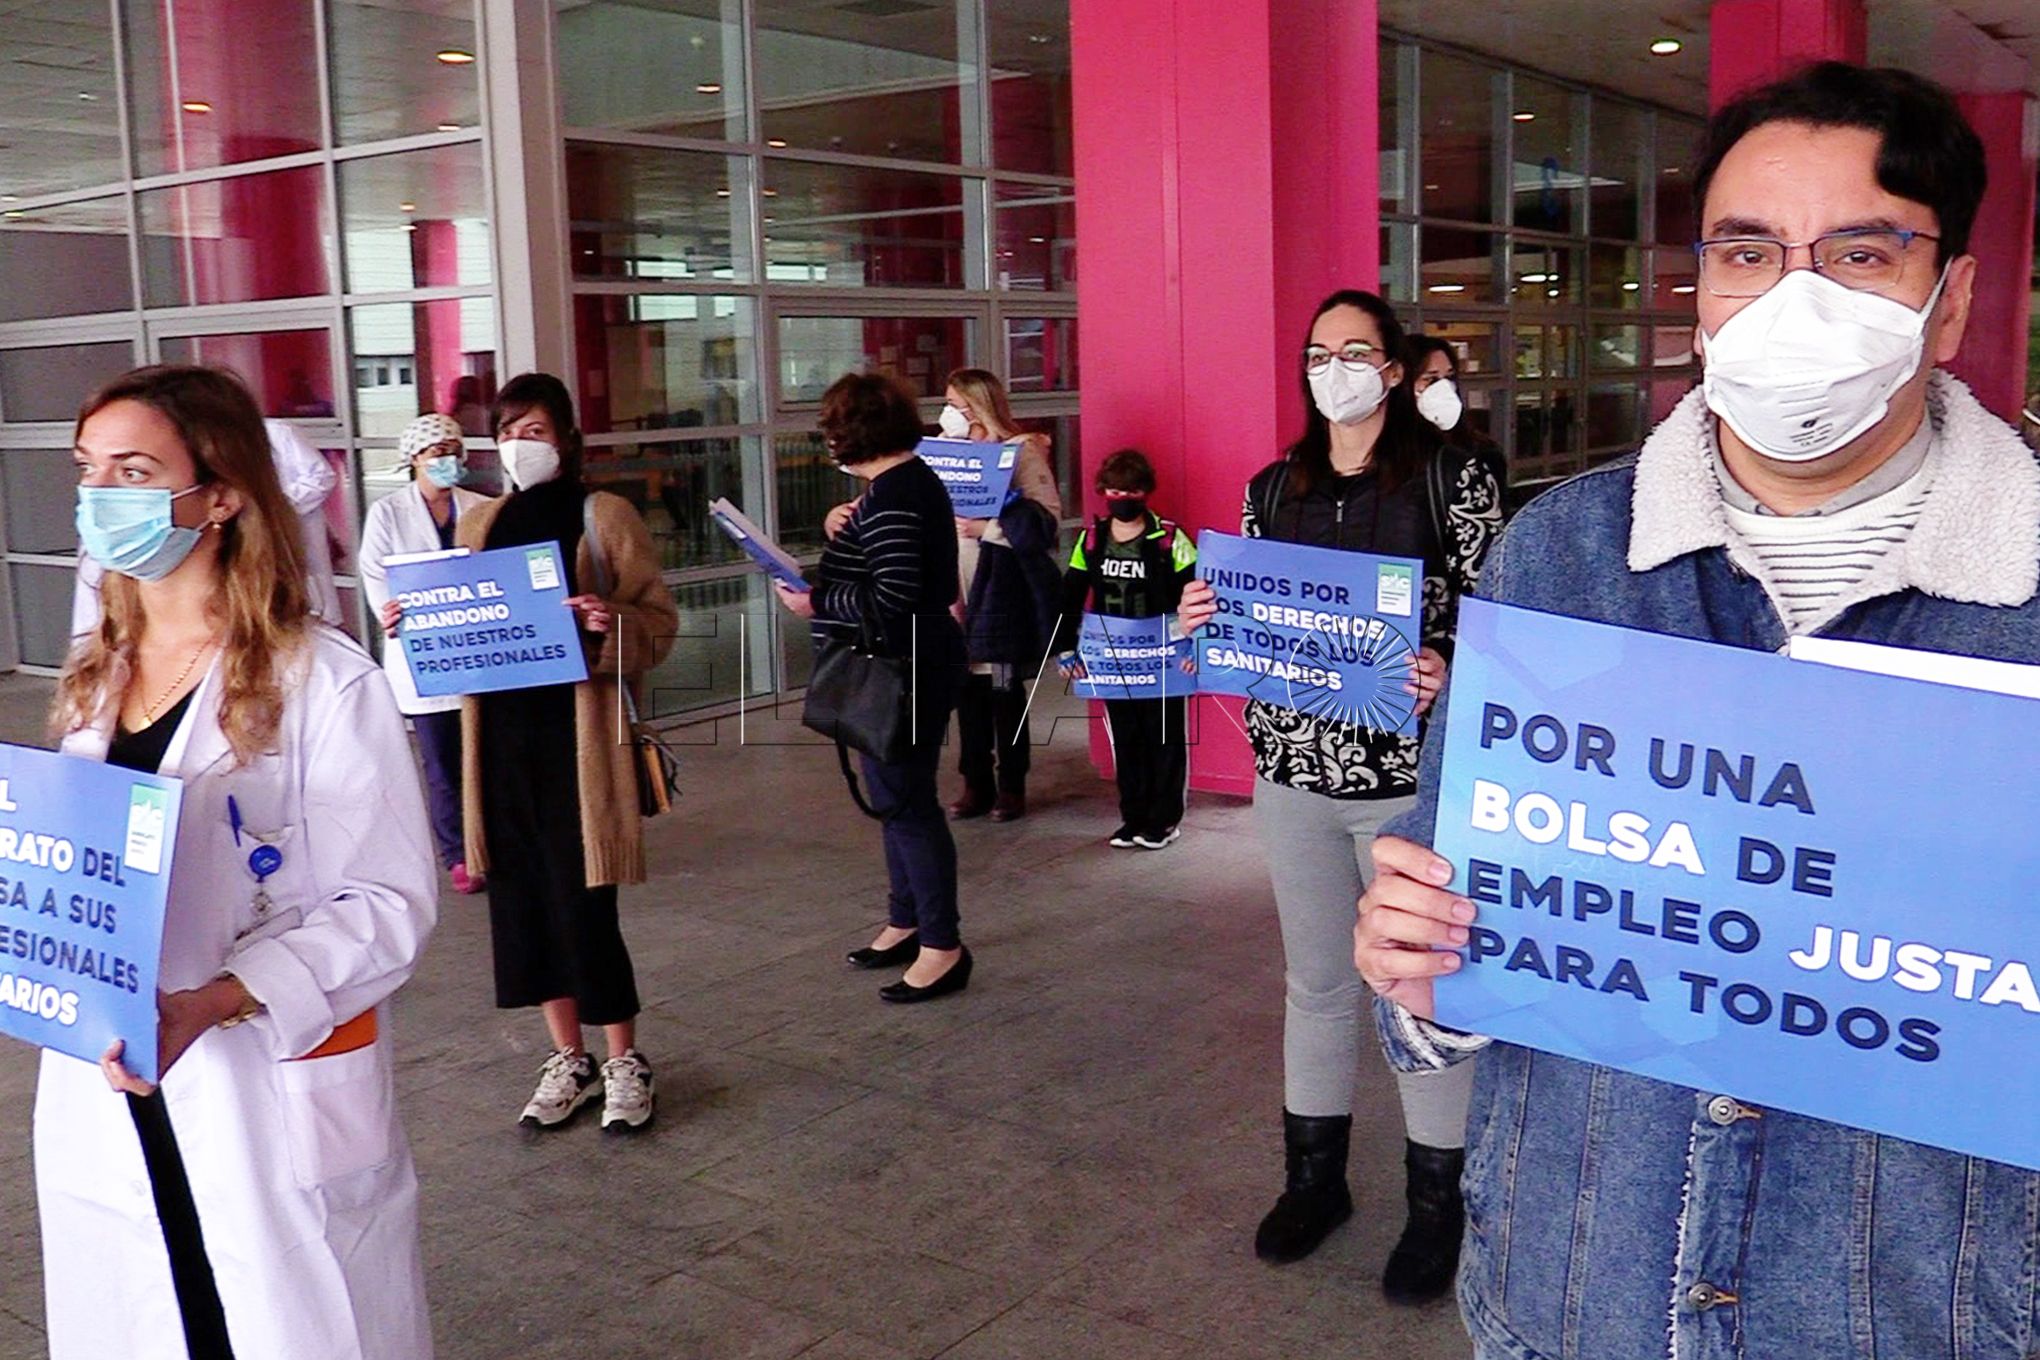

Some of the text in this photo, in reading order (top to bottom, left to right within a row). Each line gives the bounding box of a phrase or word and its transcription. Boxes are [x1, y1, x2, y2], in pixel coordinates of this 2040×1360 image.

[398, 580, 505, 609] CONTRA EL
[1203, 566, 1291, 596] UNIDOS
[1301, 581, 1350, 605] POR
[403, 603, 510, 632] ABANDONO
[410, 624, 537, 652] DE NUESTROS
[1215, 597, 1386, 641] OS DERECHOS
[415, 644, 567, 675] PROFESIONALES
[1103, 645, 1176, 659] DERECHOS
[1129, 634, 1156, 644] POR
[1205, 622, 1374, 667] DE TODOS LOS
[1098, 661, 1142, 671] TODOS
[1147, 660, 1173, 670] LOS
[1206, 647, 1343, 691] SANITARIOS
[1481, 701, 1815, 815] POR UNA
[1470, 779, 1837, 898] BOLSA DE
[83, 846, 125, 888] DEL
[38, 887, 58, 917] A
[69, 894, 117, 934] SUS
[1468, 858, 2040, 1014] EMPLEO JUSTA
[1469, 926, 1942, 1063] PARA TODOS
